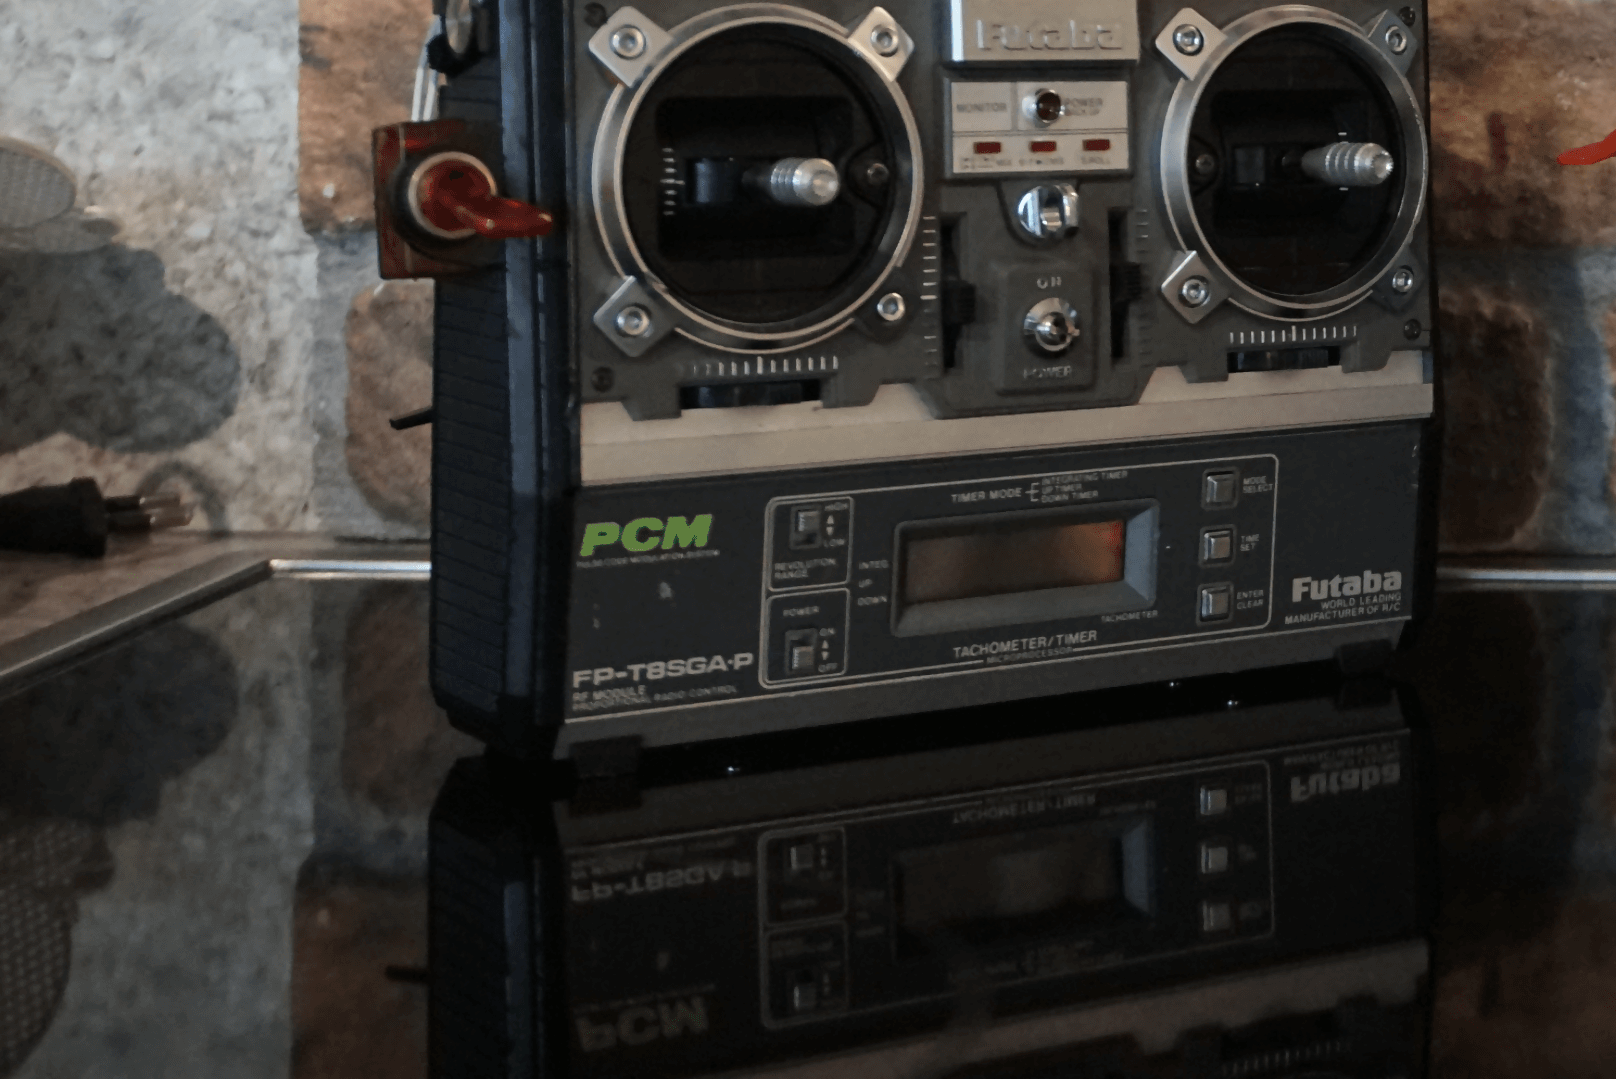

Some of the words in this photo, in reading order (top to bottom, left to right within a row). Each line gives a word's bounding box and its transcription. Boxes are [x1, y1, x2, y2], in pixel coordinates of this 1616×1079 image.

[976, 19, 1123, 51] Futaba
[1036, 276, 1062, 289] ON
[1022, 365, 1072, 379] POWER
[1101, 470, 1129, 481] TIMER
[1242, 475, 1267, 485] MODE
[1041, 485, 1054, 495] UP
[1055, 482, 1083, 493] TIMER
[1242, 483, 1274, 494] SELECT
[950, 490, 986, 504] TIMER
[989, 487, 1023, 500] MODE
[1041, 494, 1070, 504] DOWN
[1071, 490, 1099, 500] TIMER
[824, 502, 849, 512] HIGH
[579, 513, 713, 556] PCM
[1240, 533, 1260, 543] TIME
[1239, 542, 1257, 552] SET
[774, 558, 837, 571] REVOLUTION
[774, 569, 809, 580] RANGE
[858, 578, 874, 589] UP
[1292, 569, 1402, 603] Futaba
[1236, 588, 1265, 600] ENTER
[857, 595, 888, 607] DOWN
[1236, 598, 1265, 610] CLEAR
[1320, 597, 1356, 610] WORLD
[1359, 592, 1402, 606] LEADING
[782, 605, 821, 618] POWER
[1101, 609, 1159, 624] TACHOMETER
[1284, 606, 1365, 625] MANUFACTURER
[1366, 604, 1380, 615] OF
[1382, 601, 1401, 613] R/C
[818, 627, 837, 637] ON
[986, 647, 1074, 665] MICROPROCESSOR
[818, 662, 839, 673] OFF
[572, 690, 589, 702] RF
[592, 684, 647, 700] MODULE
[653, 690, 687, 702] RADIO
